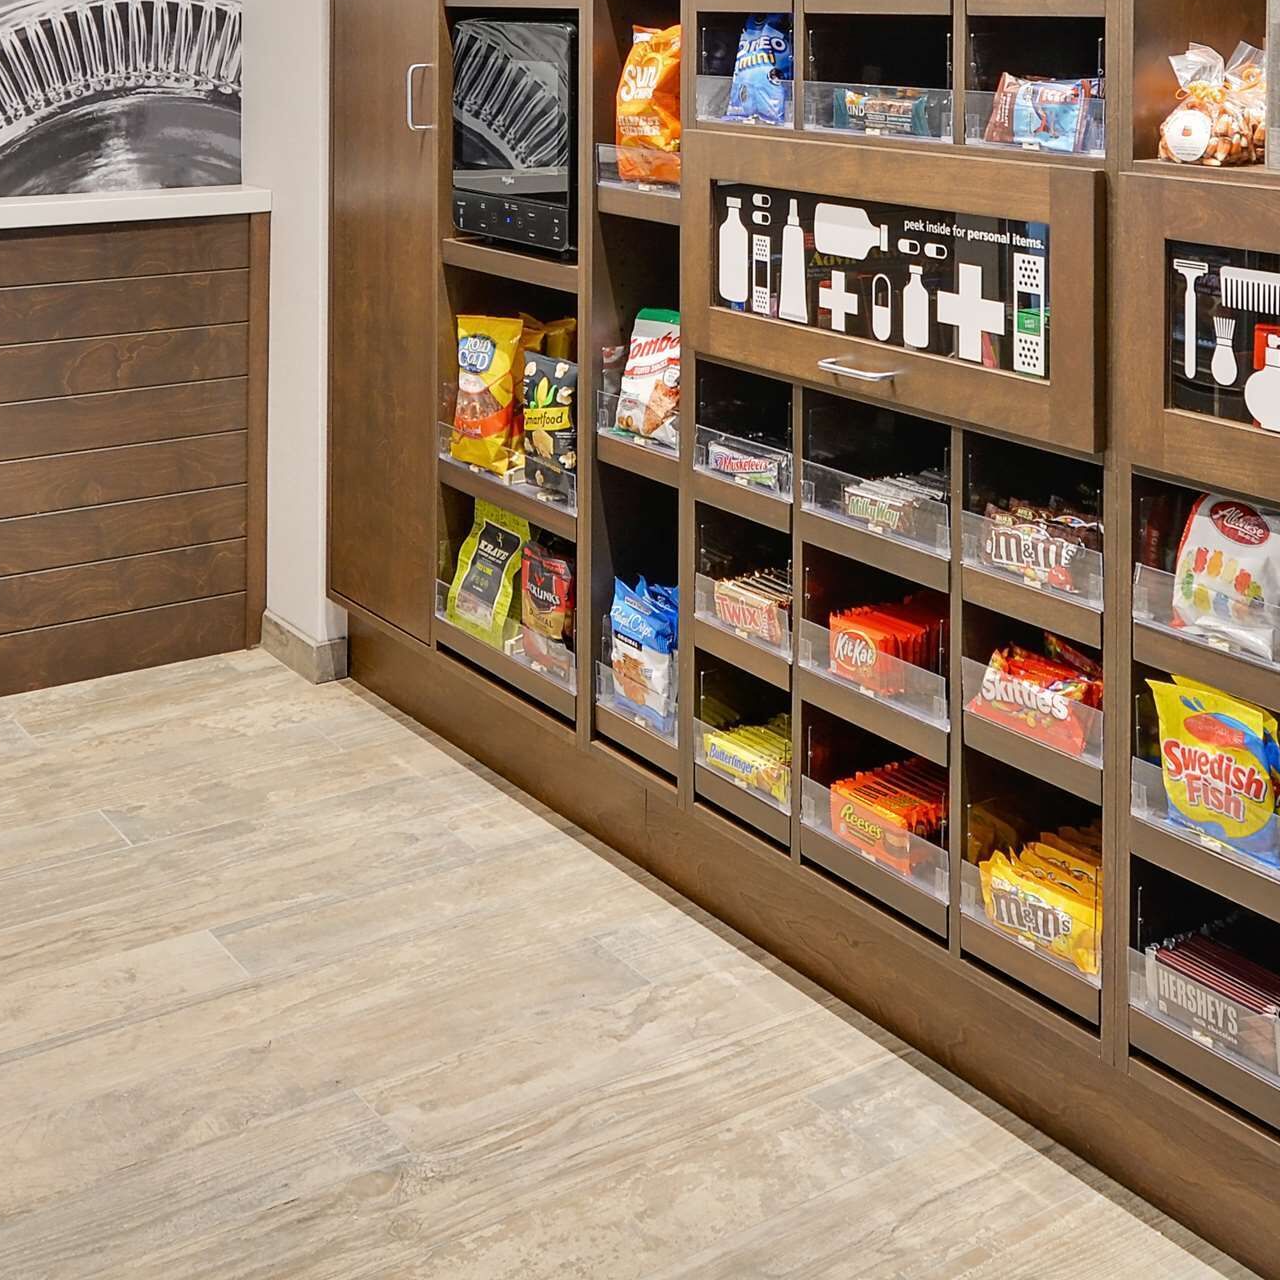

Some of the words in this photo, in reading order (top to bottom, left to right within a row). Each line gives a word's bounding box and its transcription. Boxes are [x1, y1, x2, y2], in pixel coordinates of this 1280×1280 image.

[738, 51, 776, 70] mini
[904, 219, 925, 234] peek
[926, 222, 952, 237] inside
[952, 225, 965, 237] for
[966, 227, 1011, 245] personal
[1012, 233, 1046, 250] items.
[478, 540, 509, 560] KRAVE
[980, 670, 1070, 720] Skittles
[709, 742, 754, 776] Butterfinger
[1163, 740, 1267, 803] Swedish
[1185, 774, 1245, 822] Fish
[1158, 970, 1238, 1036] HERSHEY'S
